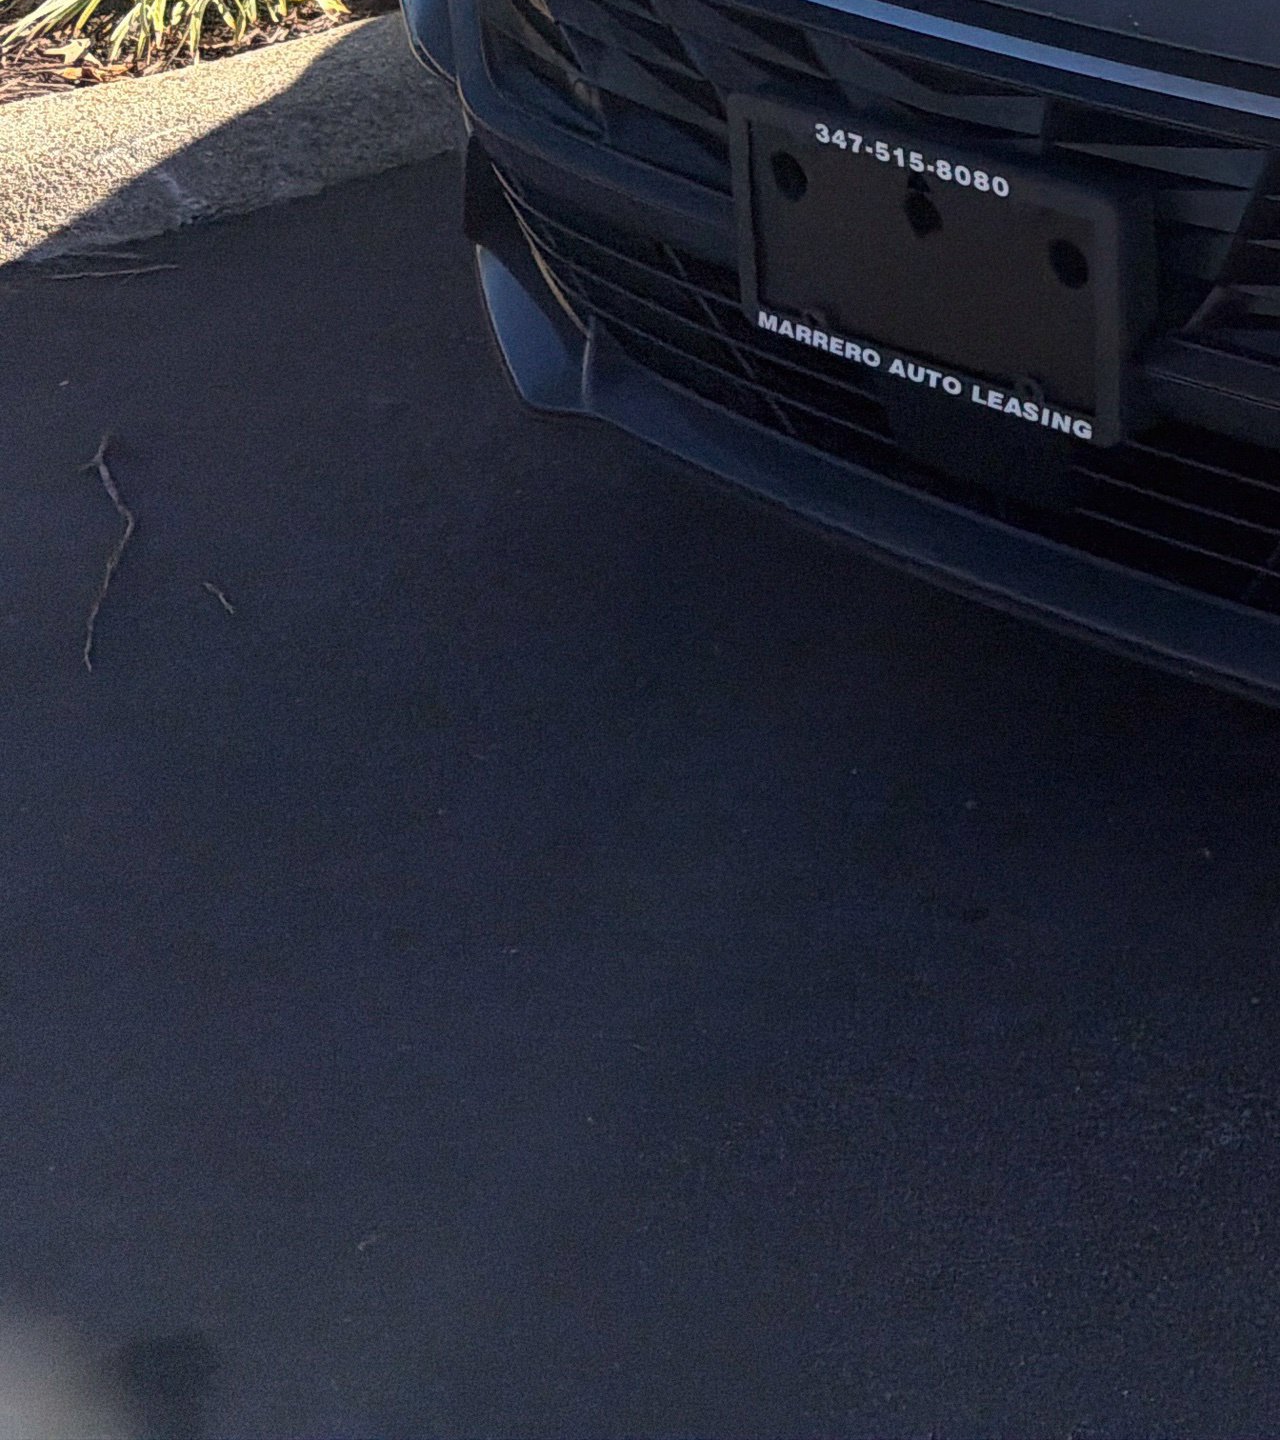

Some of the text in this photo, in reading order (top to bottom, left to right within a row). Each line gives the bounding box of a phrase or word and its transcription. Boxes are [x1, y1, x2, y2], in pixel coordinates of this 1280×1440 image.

[814, 123, 1011, 197] 347-515-8080
[757, 311, 1093, 441] MARRERO AUTO LEASING
